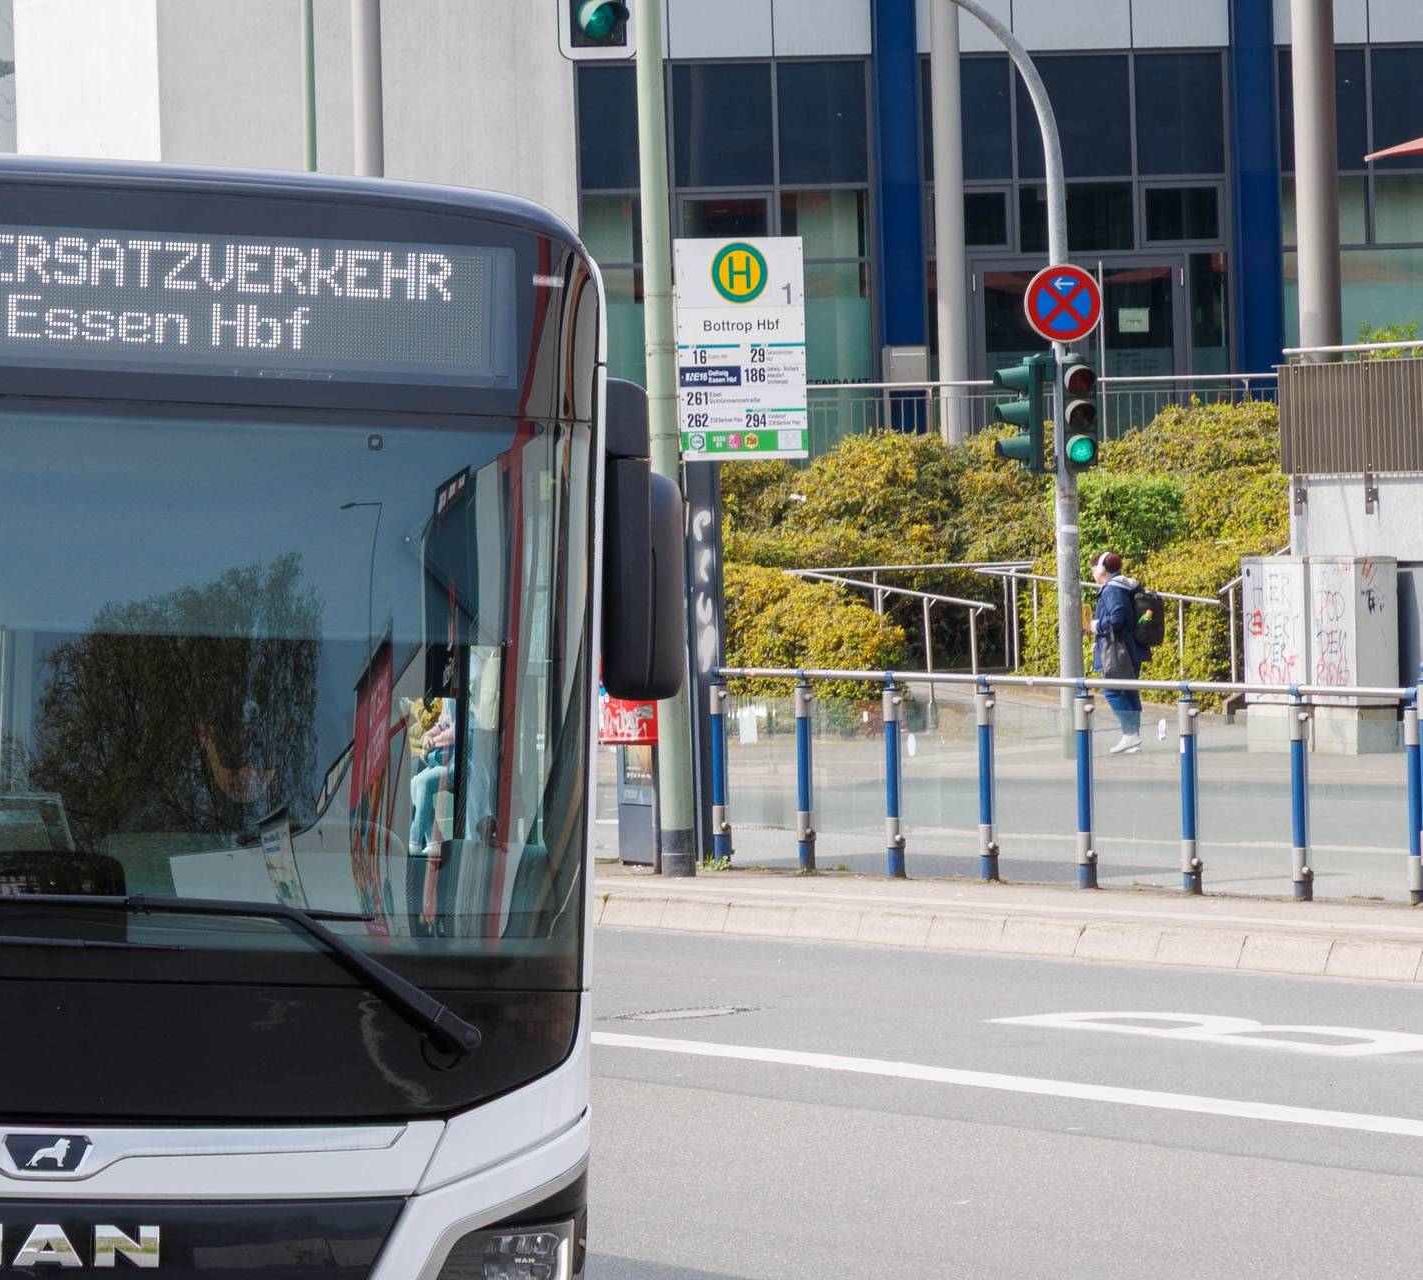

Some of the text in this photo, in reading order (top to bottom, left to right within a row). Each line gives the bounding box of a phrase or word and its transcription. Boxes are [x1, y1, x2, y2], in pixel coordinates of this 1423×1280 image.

[728, 255, 751, 289] H
[781, 283, 791, 305] 1
[6, 293, 189, 346] Essen
[211, 302, 311, 350] Hbf
[703, 318, 780, 334] Bottrop Hbf
[692, 349, 707, 365] 16
[750, 348, 766, 363] 29
[744, 367, 766, 383] 186
[686, 391, 709, 406] 261
[687, 413, 710, 428] 262
[745, 412, 767, 428] 294
